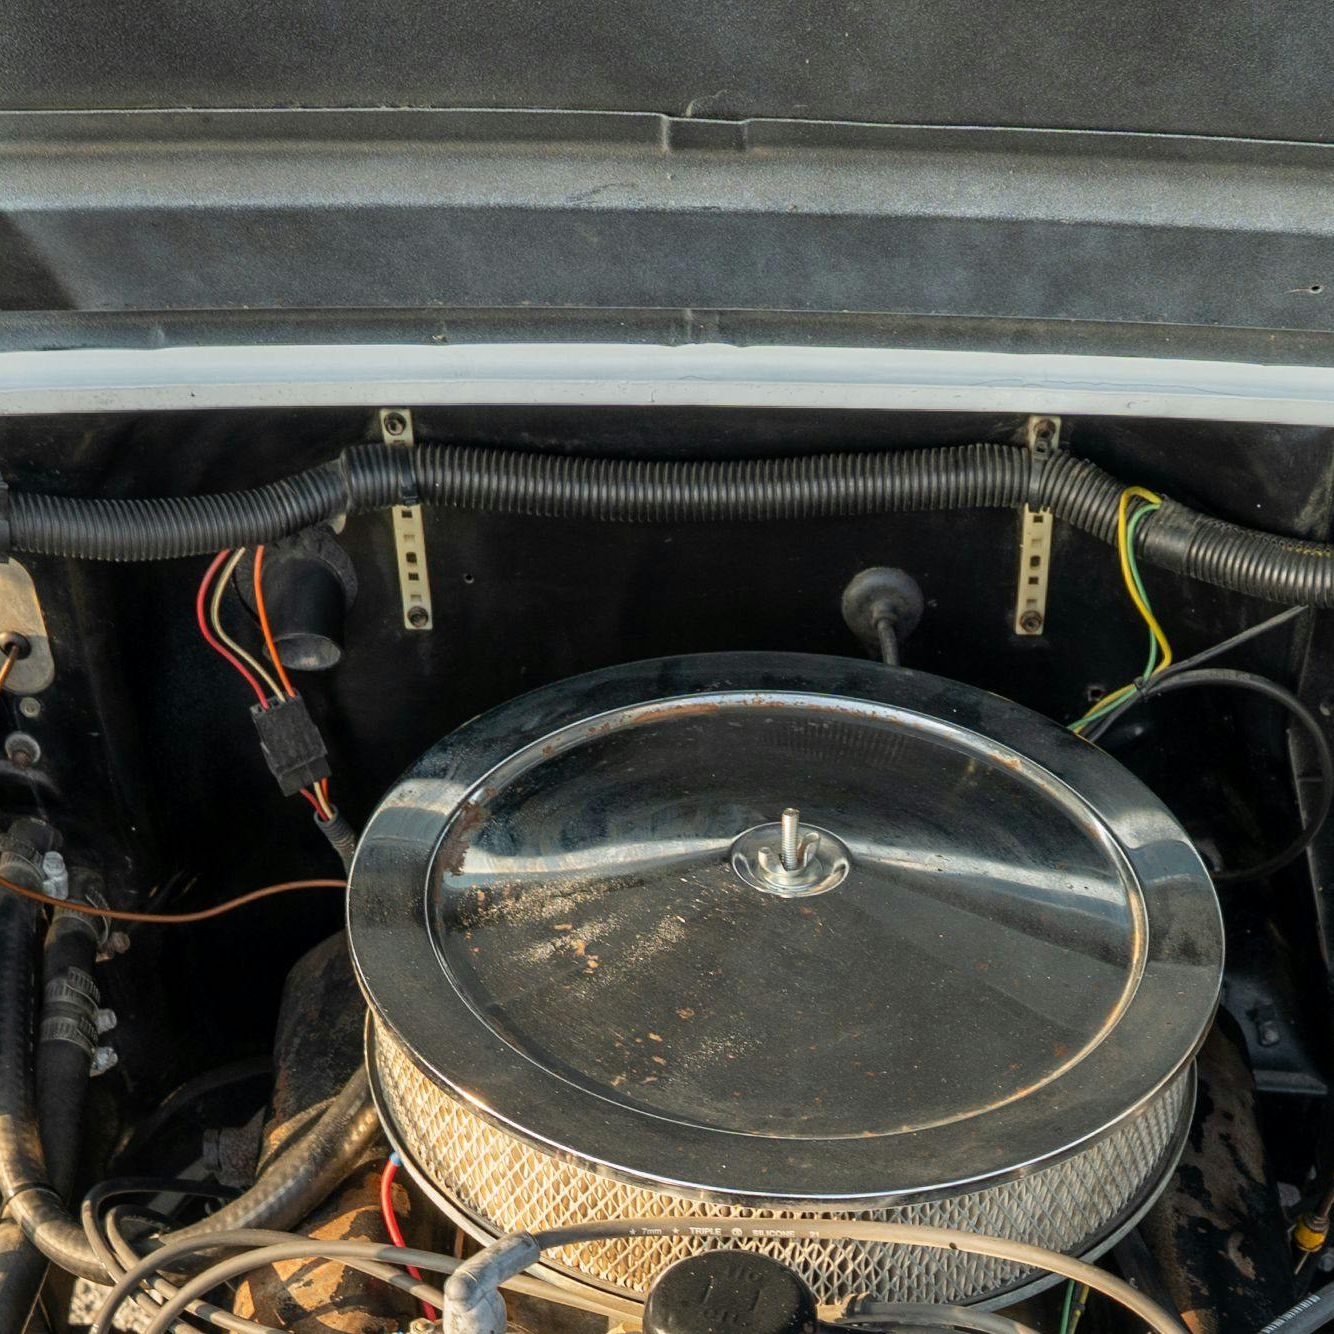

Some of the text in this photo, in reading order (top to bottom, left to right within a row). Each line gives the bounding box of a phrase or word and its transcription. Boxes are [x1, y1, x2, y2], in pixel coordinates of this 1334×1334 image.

[641, 1227, 662, 1235] 7mm
[689, 1227, 722, 1236] TRIPLE
[752, 1229, 796, 1238] SILICONE
